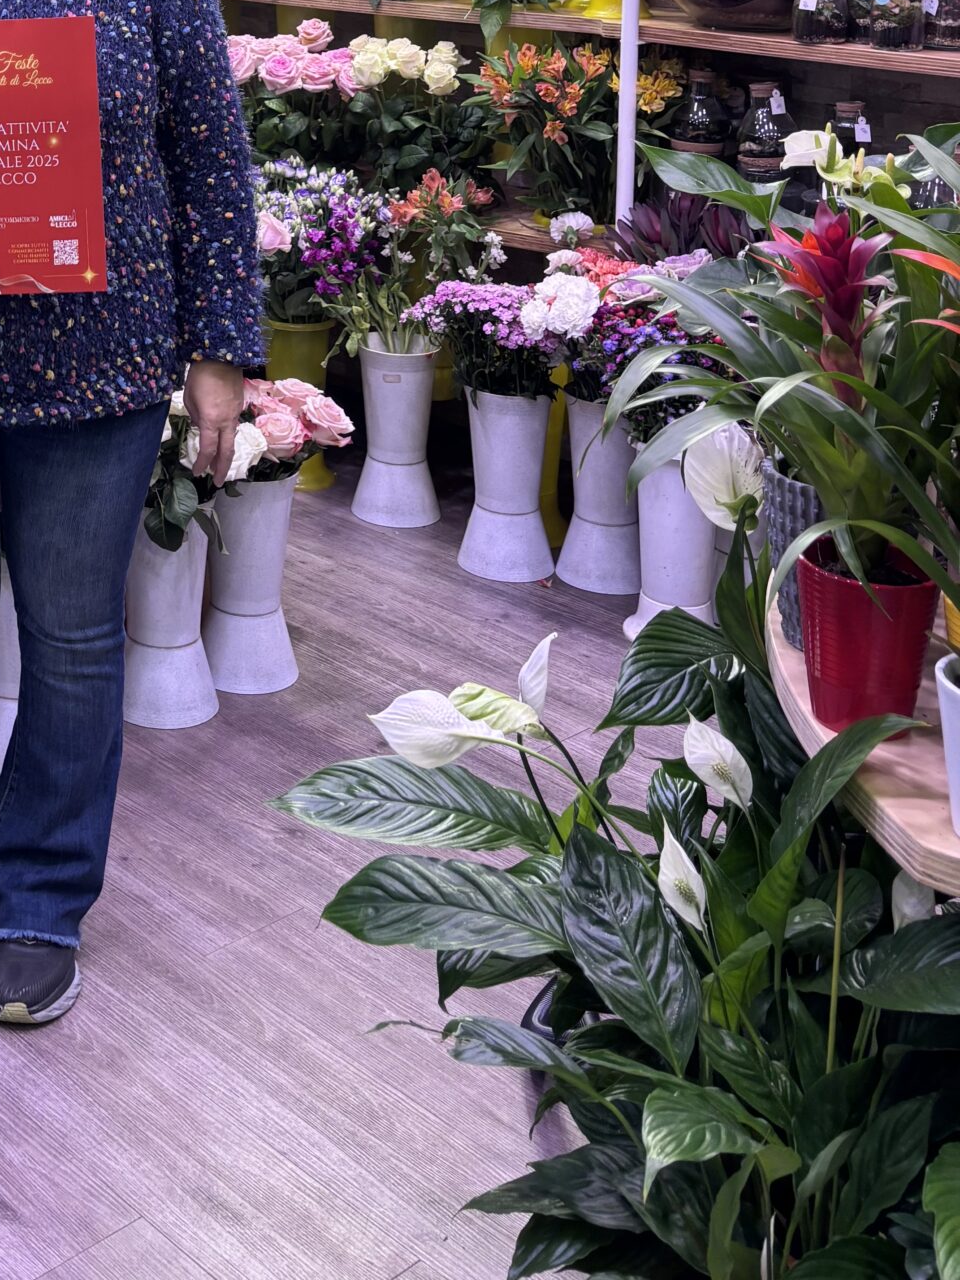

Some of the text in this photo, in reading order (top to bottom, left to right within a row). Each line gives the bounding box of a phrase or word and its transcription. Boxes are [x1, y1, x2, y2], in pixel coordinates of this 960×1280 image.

[10, 73, 20, 86] di
[23, 70, 53, 89] Lecco
[26, 154, 59, 168] 2025
